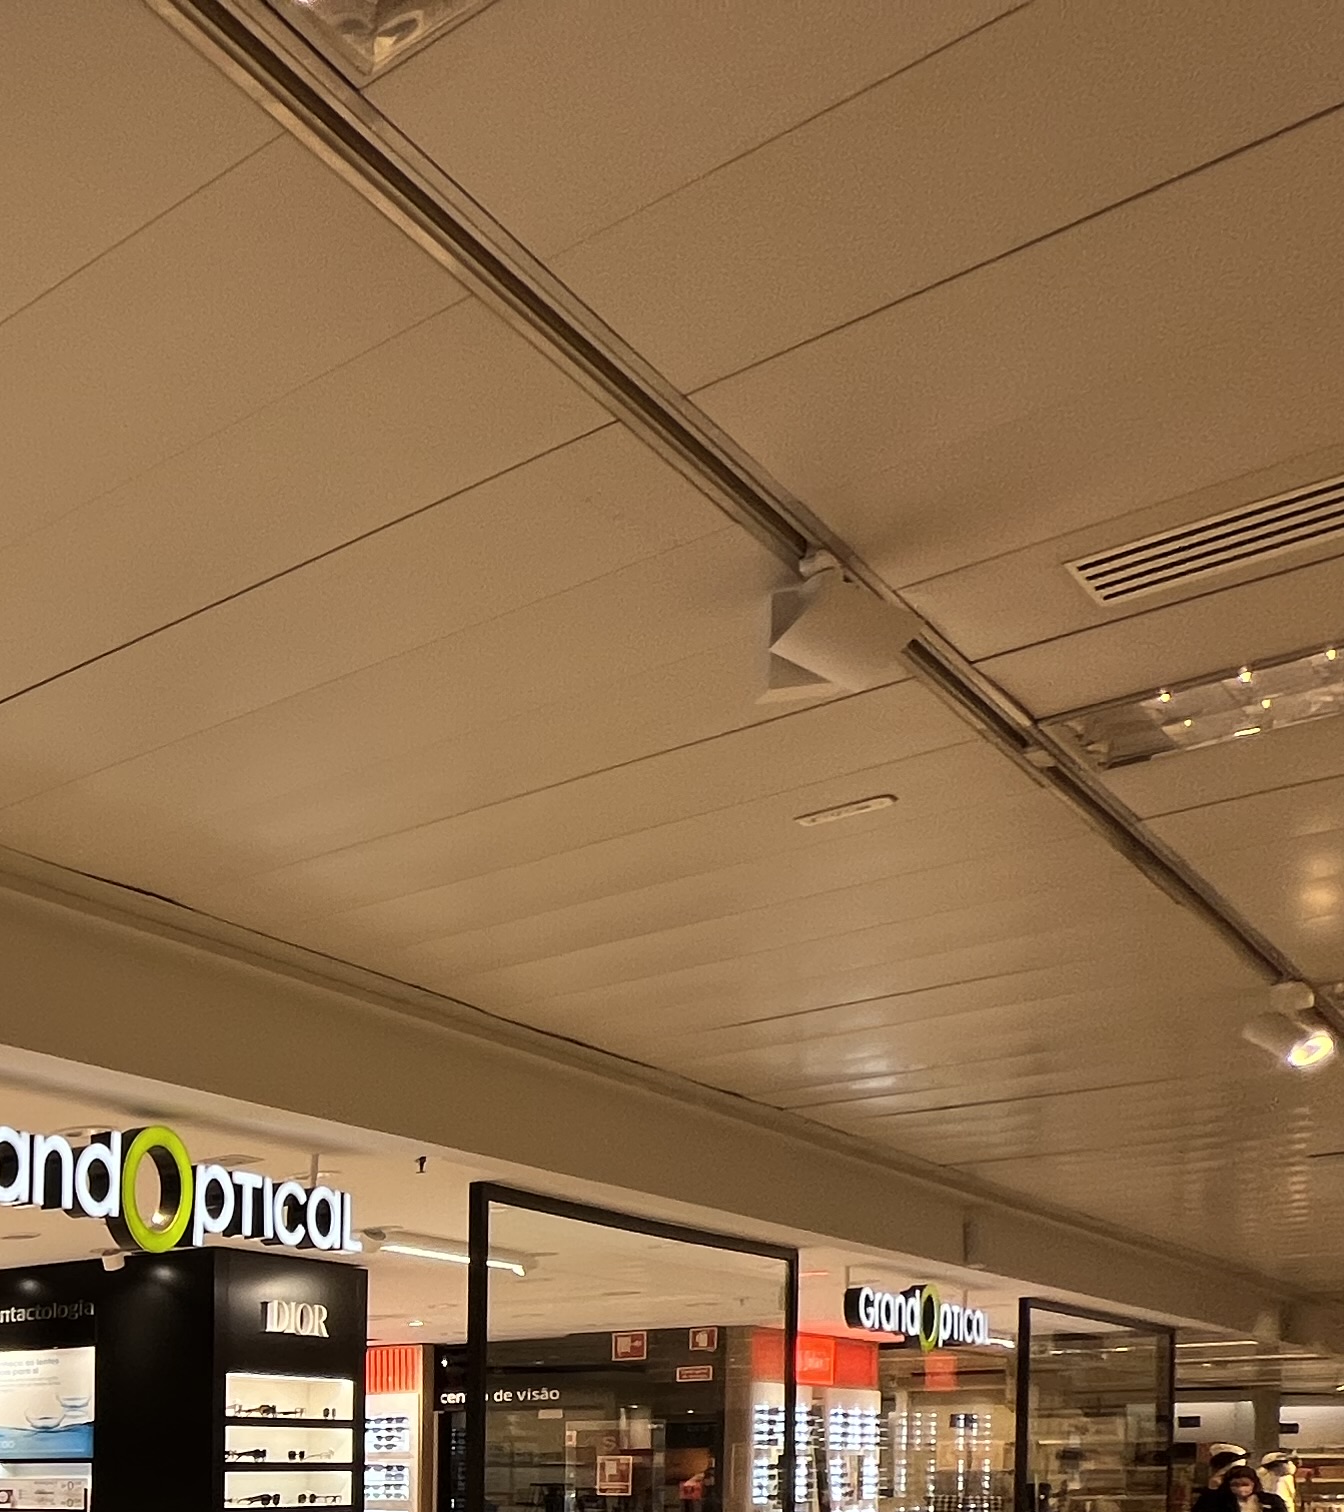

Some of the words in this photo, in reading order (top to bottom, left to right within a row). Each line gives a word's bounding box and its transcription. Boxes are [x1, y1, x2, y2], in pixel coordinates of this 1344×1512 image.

[265, 1300, 330, 1338] DIOR
[493, 1389, 513, 1403] de
[516, 1387, 561, 1402] visão
